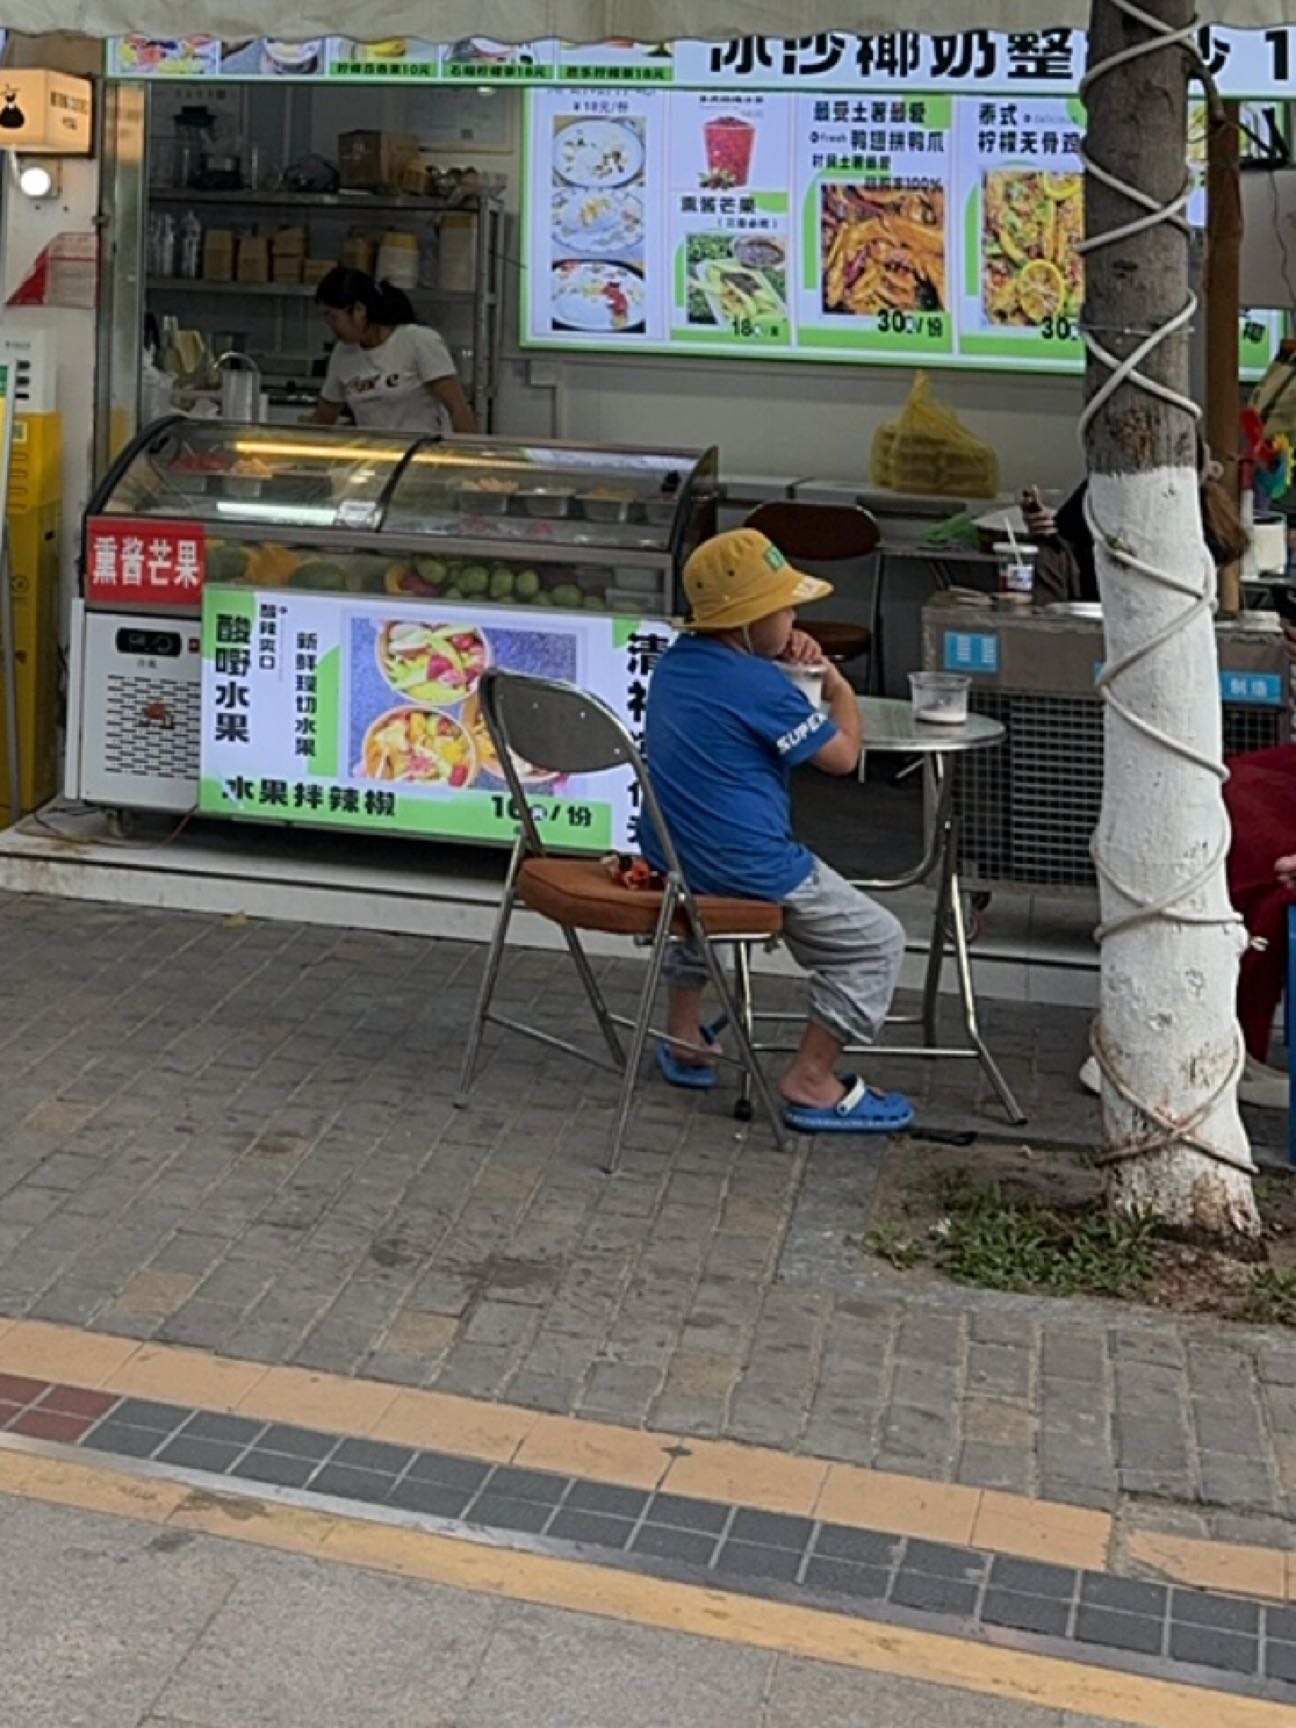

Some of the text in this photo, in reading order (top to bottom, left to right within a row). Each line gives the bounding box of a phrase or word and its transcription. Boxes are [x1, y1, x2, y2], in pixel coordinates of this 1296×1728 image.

[979, 102, 1018, 125] 泰式
[215, 613, 251, 743] 酸嘢水果
[222, 777, 396, 818] 水果拌辣椒
